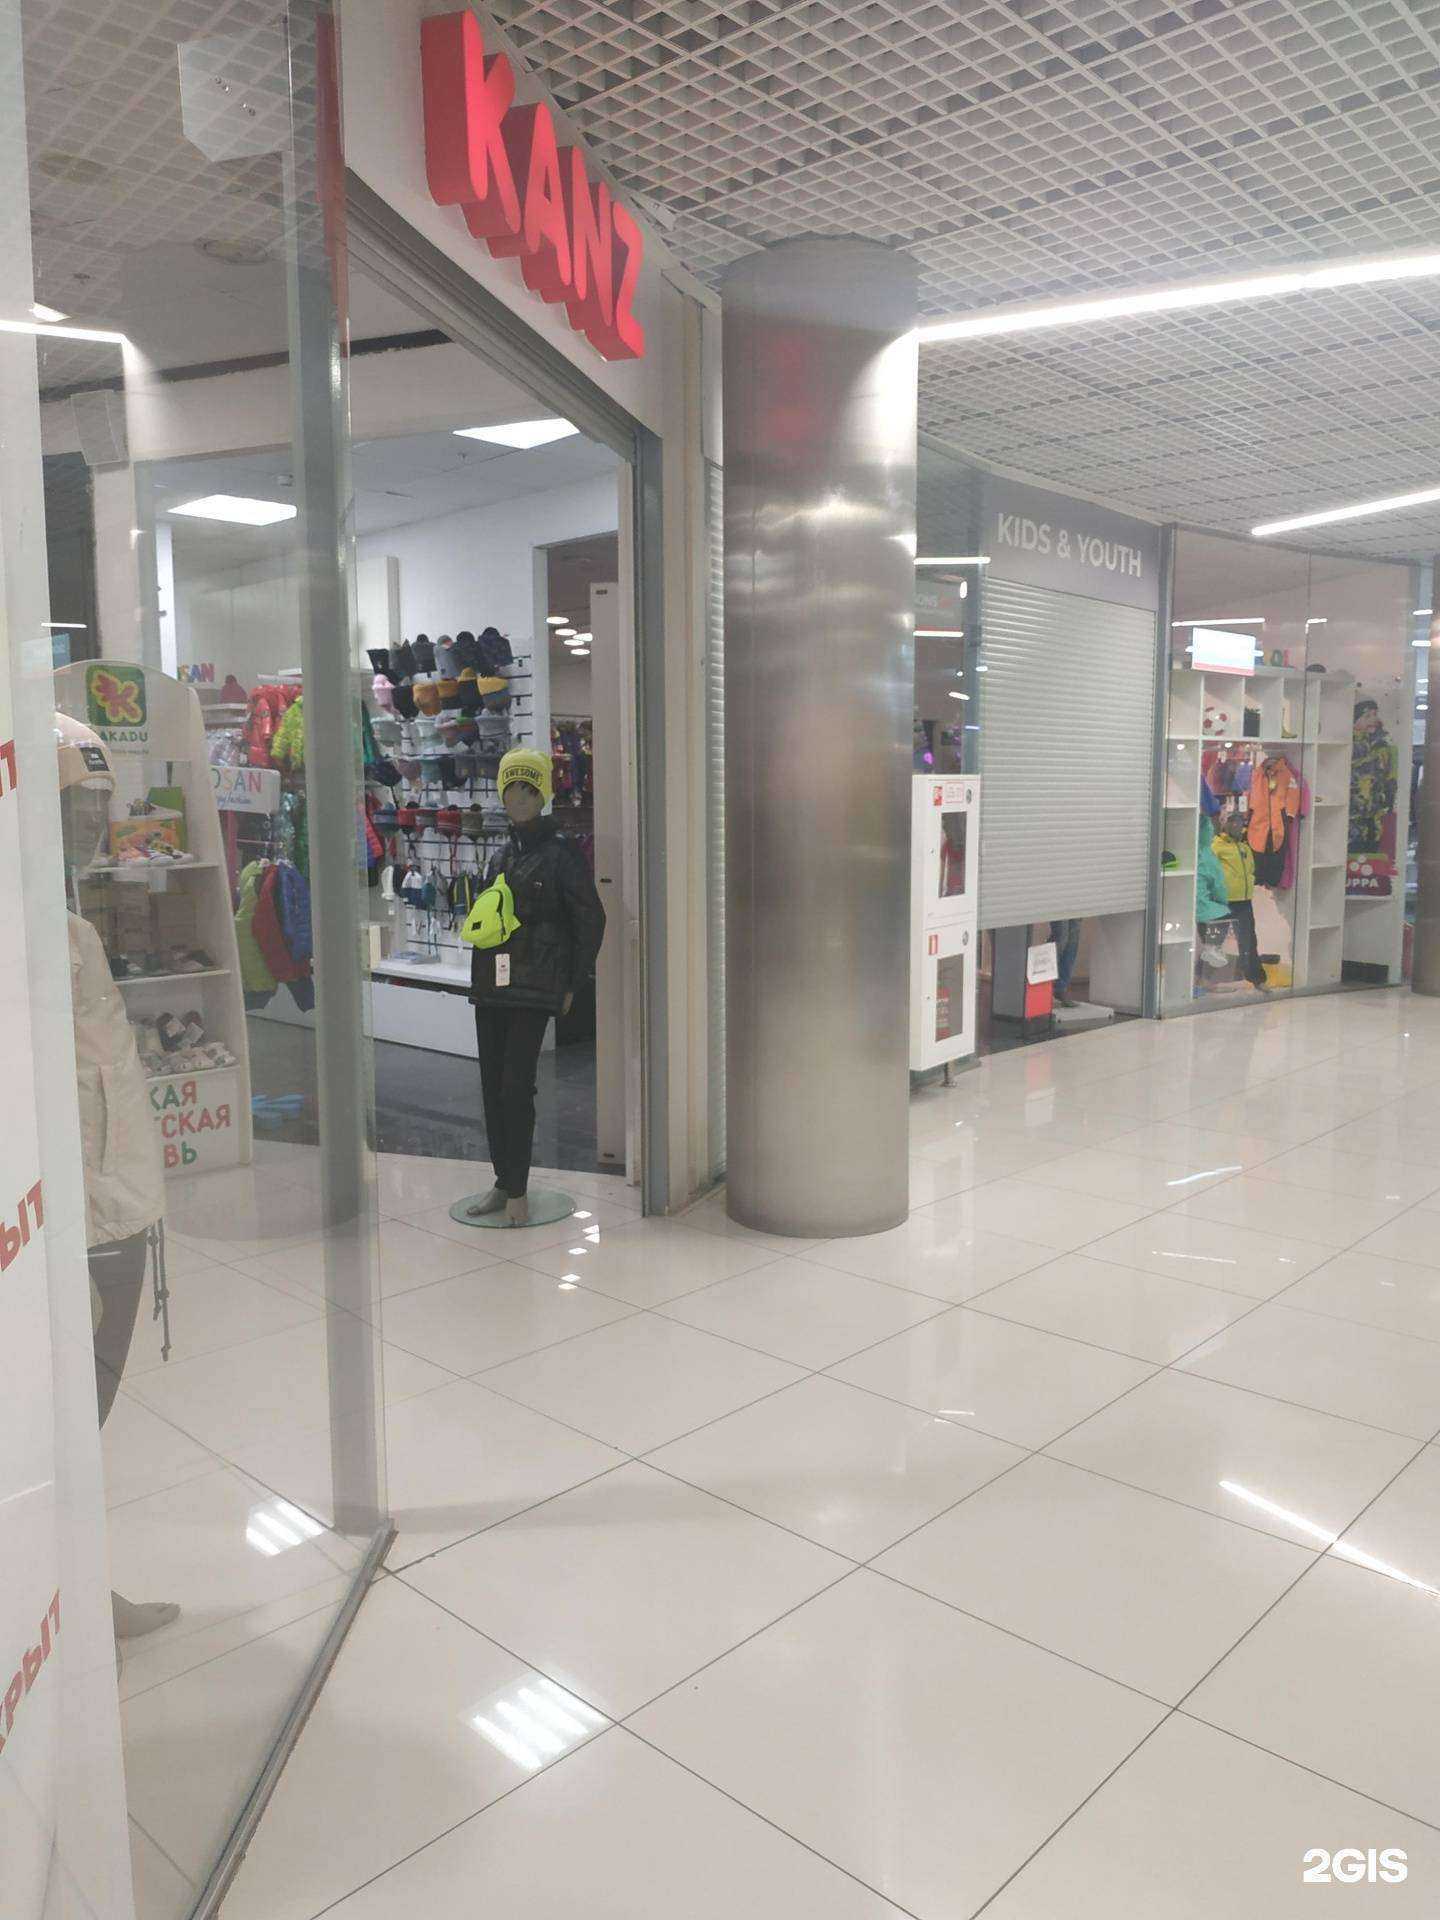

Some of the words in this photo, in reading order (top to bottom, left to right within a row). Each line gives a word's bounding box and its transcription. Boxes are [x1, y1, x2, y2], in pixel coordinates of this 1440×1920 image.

[420, 8, 645, 362] KANZ
[998, 512, 1051, 554] KIDS
[1056, 529, 1071, 559] &
[1077, 533, 1142, 578] YOUTH
[154, 1104, 231, 1138] СКАЯ
